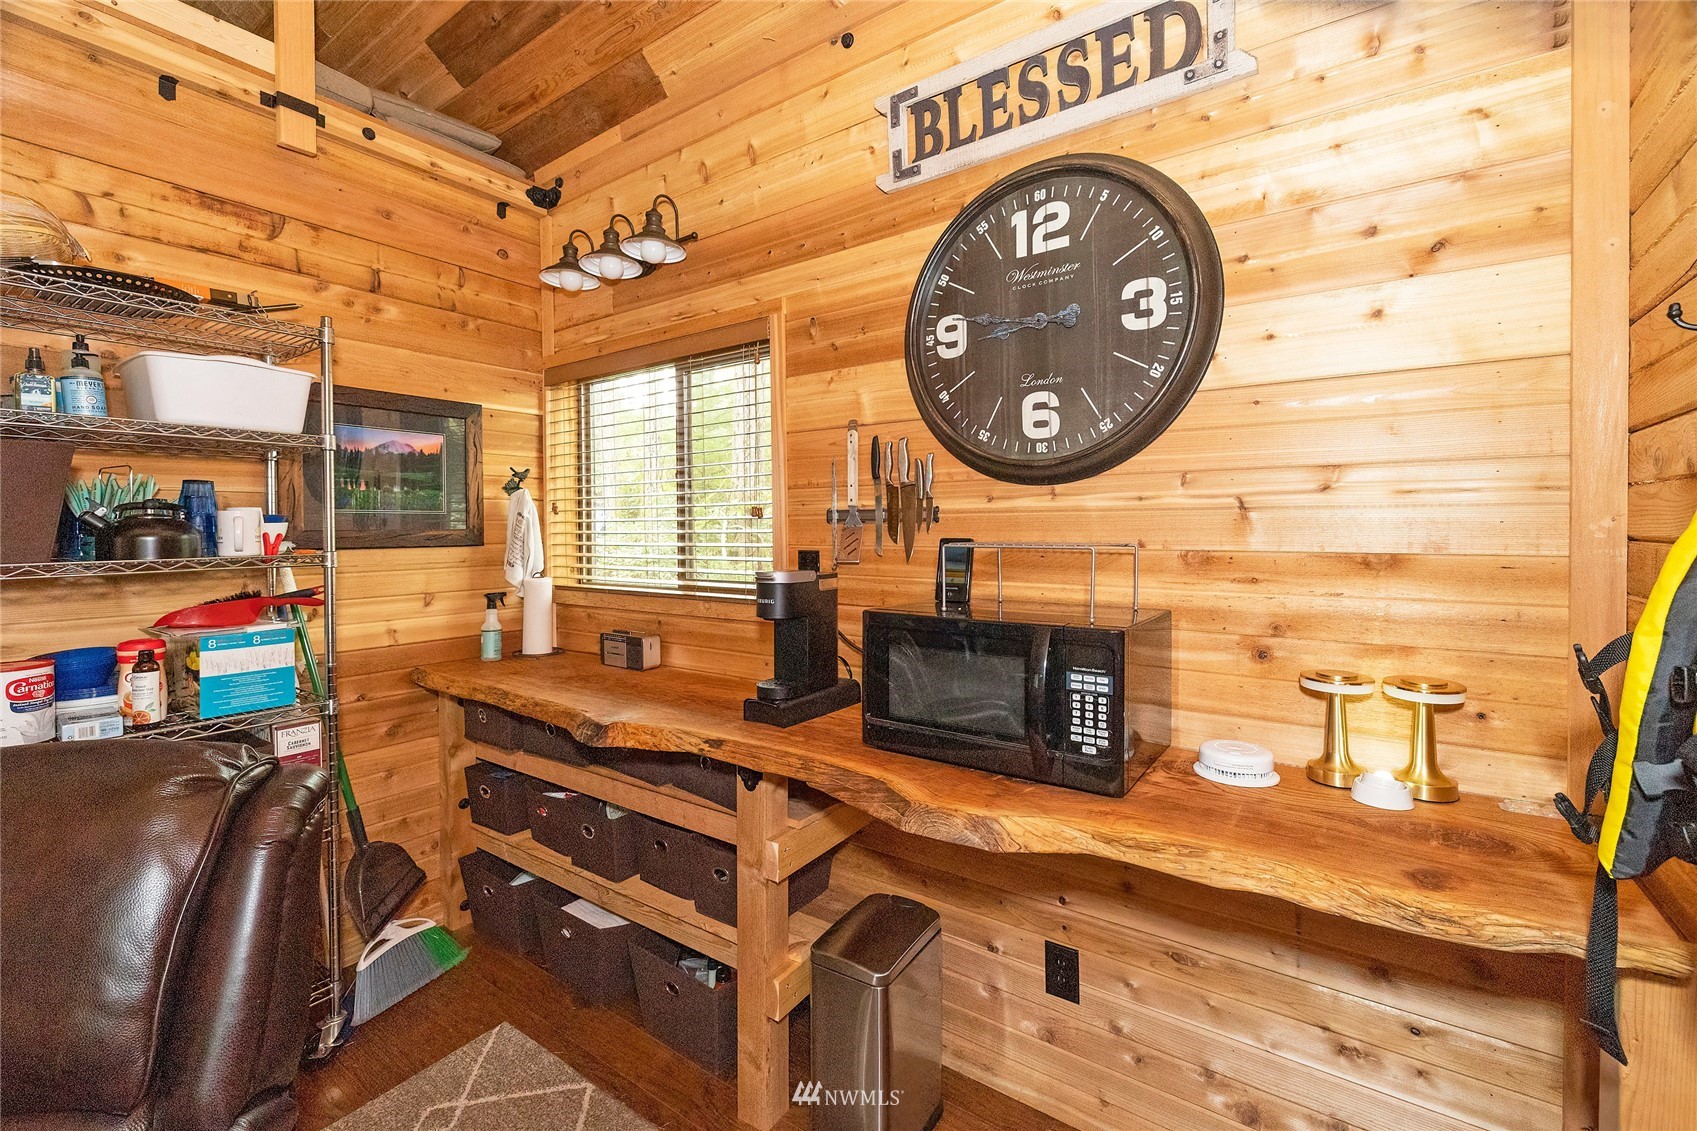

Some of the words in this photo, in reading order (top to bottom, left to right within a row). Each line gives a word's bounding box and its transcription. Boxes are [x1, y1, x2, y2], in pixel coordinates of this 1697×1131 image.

[909, 0, 1203, 163] BLESSED
[1034, 189, 1047, 201] 60
[1099, 189, 1109, 201] 5
[976, 220, 989, 235] 55
[1010, 201, 1070, 259] 12
[1148, 225, 1163, 241] 10
[1005, 261, 1081, 284] Westminster
[938, 275, 950, 287] 50
[1012, 281, 1036, 291] CLOCK
[1036, 274, 1075, 286] COMPANY
[1121, 276, 1167, 331] 3
[1170, 290, 1182, 305] 15
[926, 335, 935, 347] 45
[936, 314, 967, 359] 9
[1149, 362, 1164, 378] 20
[1019, 372, 1063, 388] London
[939, 391, 951, 403] 40
[1021, 391, 1060, 439] 6
[1099, 417, 1114, 432] 25
[978, 429, 991, 441] 35
[1036, 442, 1048, 453] 30
[208, 639, 217, 649] 8
[253, 635, 261, 644] 8
[281, 726, 316, 738] FRANZIA
